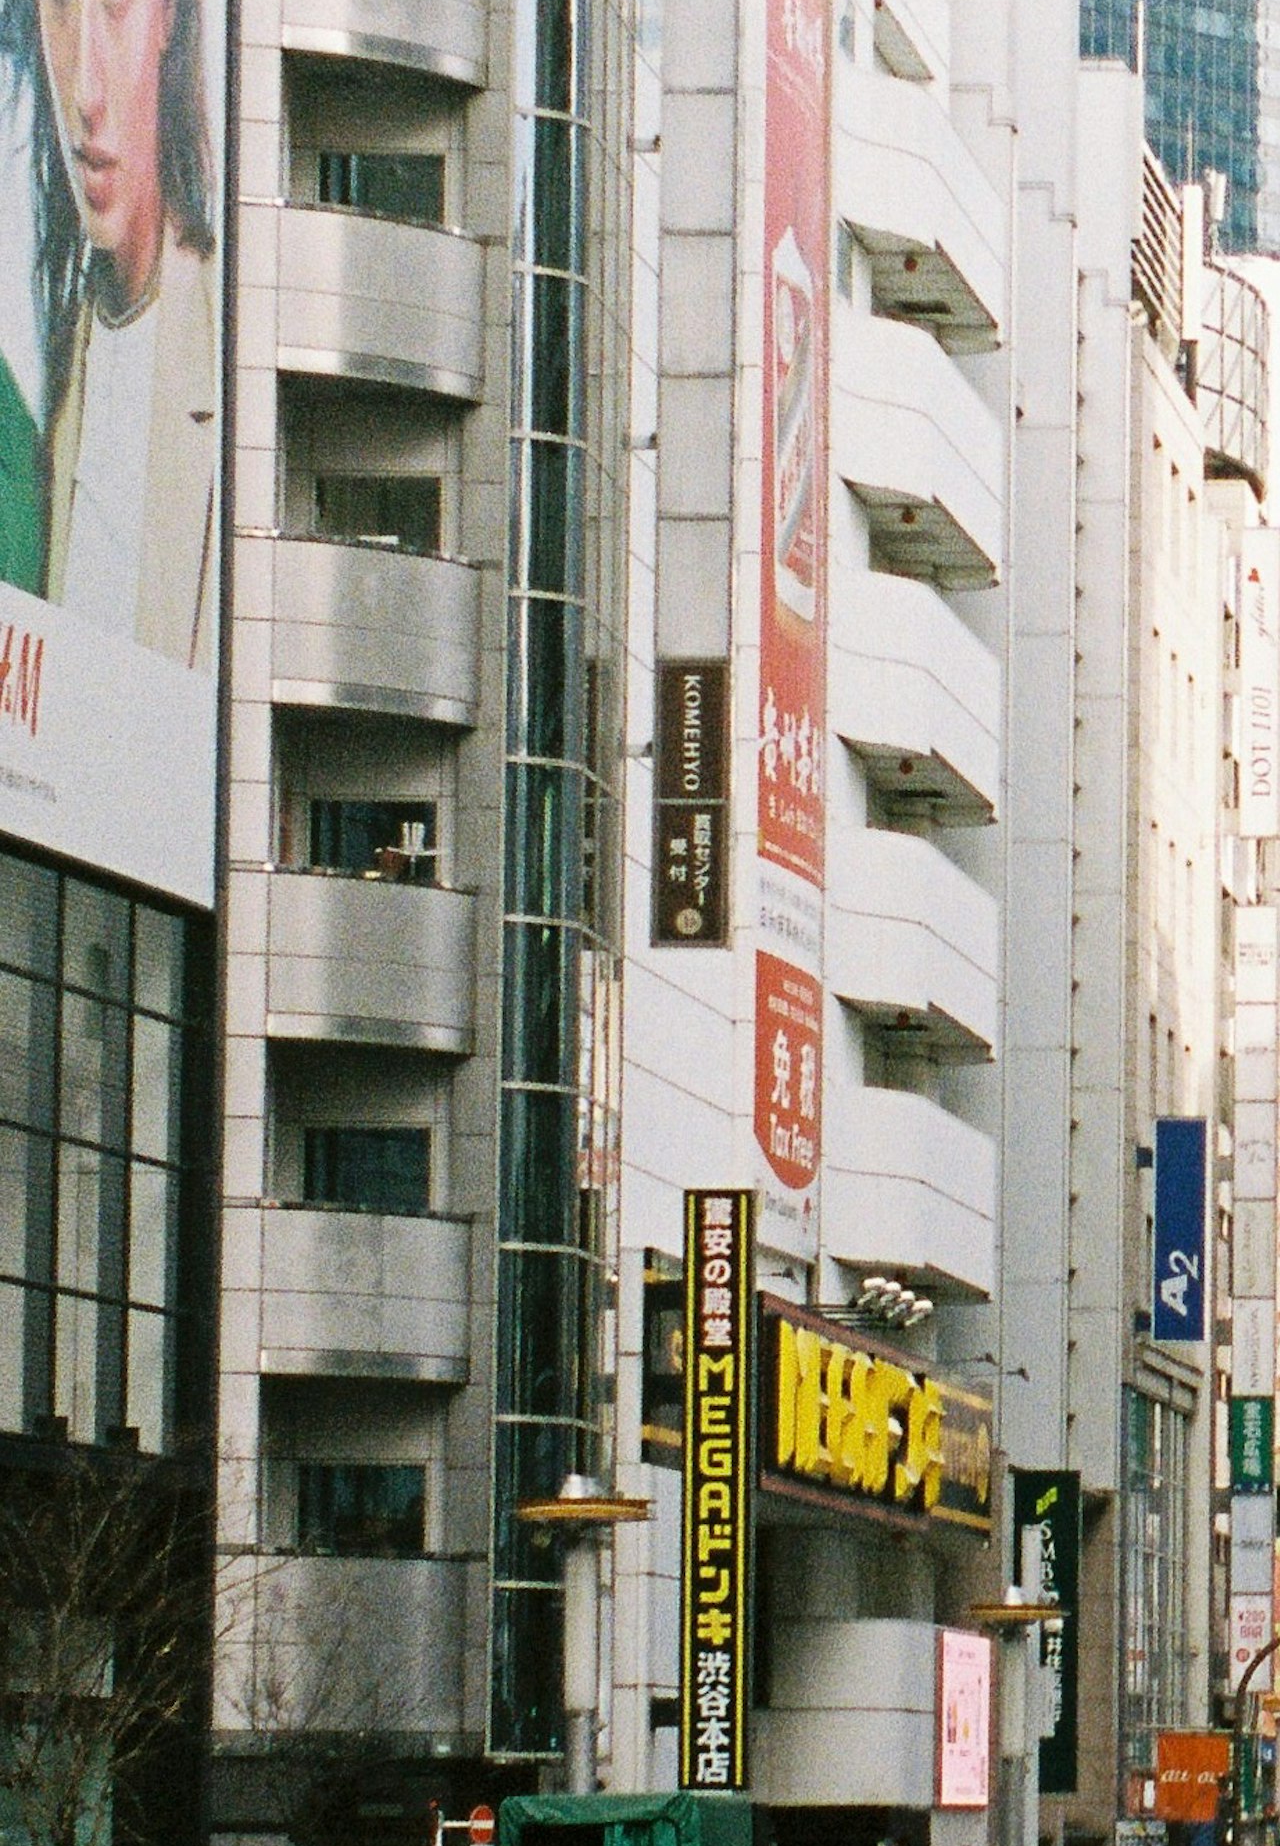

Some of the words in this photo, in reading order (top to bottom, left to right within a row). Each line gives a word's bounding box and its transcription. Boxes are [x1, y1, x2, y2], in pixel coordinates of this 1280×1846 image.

[683, 674, 702, 793] KOMEHYO
[1159, 1251, 1199, 1318] A2
[696, 1353, 735, 1646] MEGAドンキ
[696, 1651, 733, 1785] 渋谷本店
